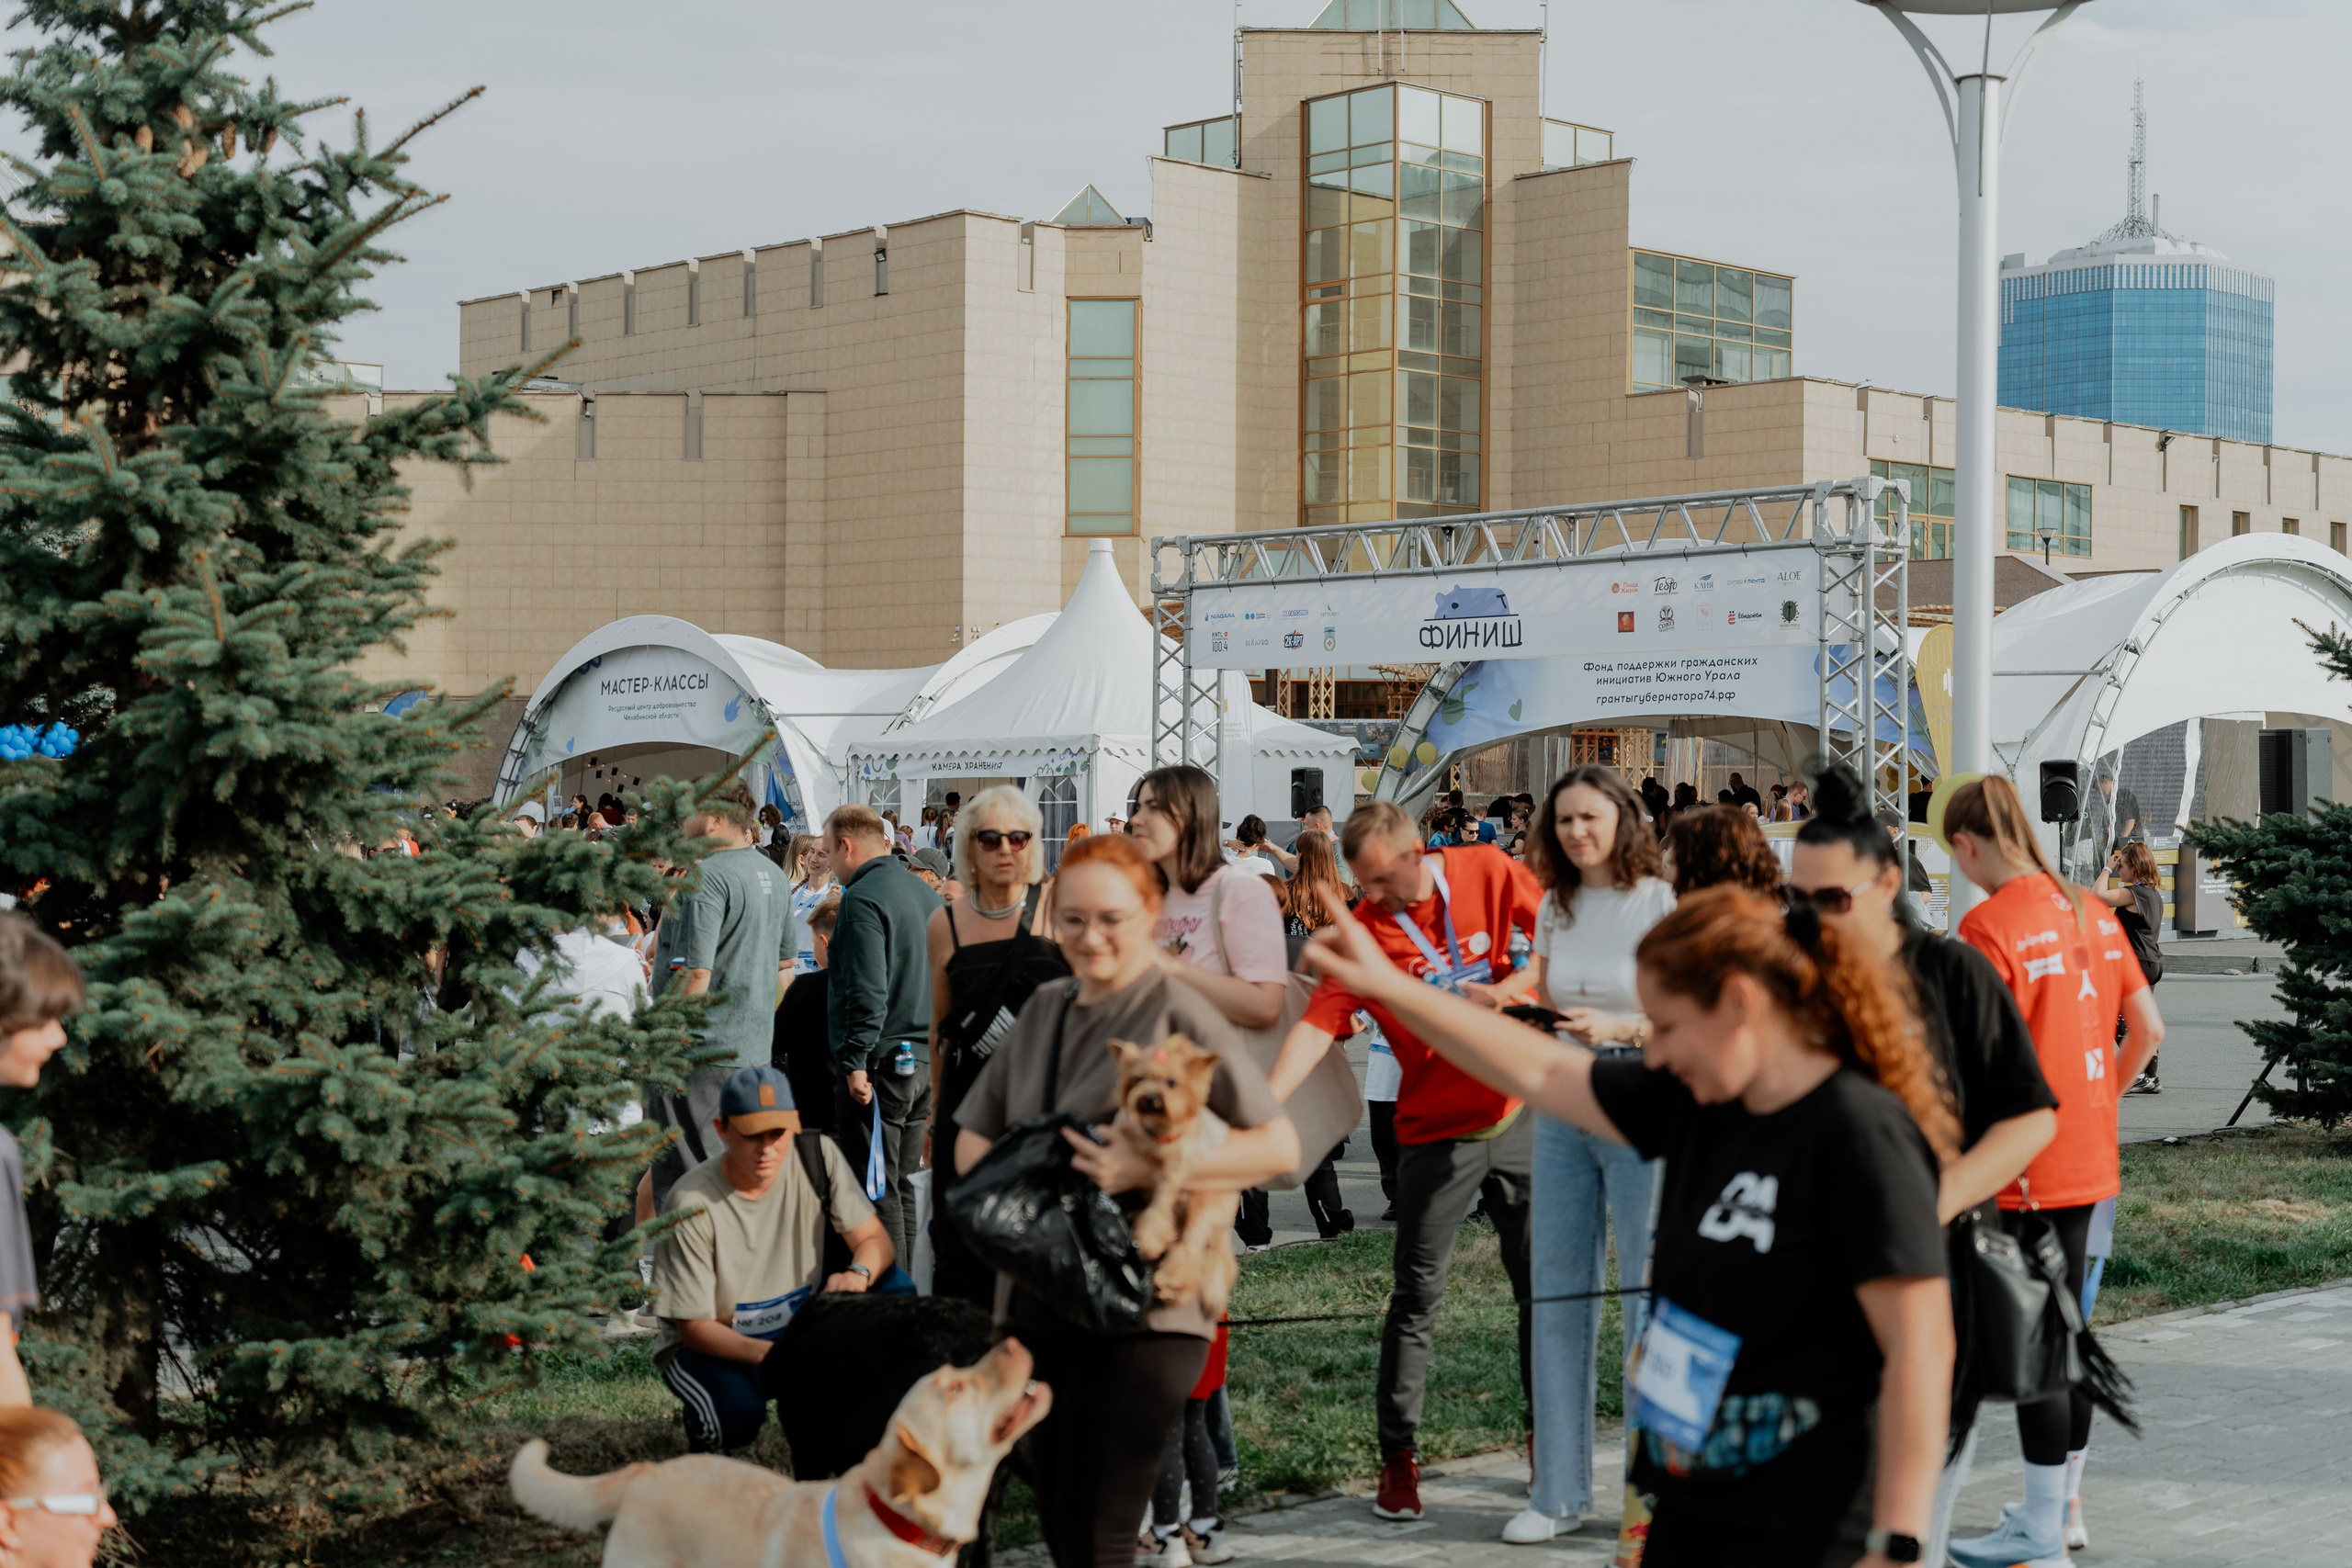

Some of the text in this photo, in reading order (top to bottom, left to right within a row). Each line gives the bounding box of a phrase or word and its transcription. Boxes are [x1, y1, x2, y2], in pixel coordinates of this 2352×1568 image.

[1777, 570, 1802, 581] ALOE
[1419, 619, 1522, 649] ФИНИШ
[1212, 640, 1228, 653] 100.4
[1583, 657, 1758, 672] Фонд поддержки гражданских
[601, 673, 709, 695] МАСТЕР-КЛАССЫ
[1596, 671, 1741, 685] инициатив Южного Урала
[1596, 690, 1736, 705] грантыгубернатора74.рф
[608, 704, 636, 713] Ресурсный
[651, 701, 696, 710] добровольчества
[623, 713, 657, 721] Челябинской
[932, 761, 1002, 772] КАМЕРА ХРАНЕНИЯ
[971, 1005, 1017, 1059] SUNWIN
